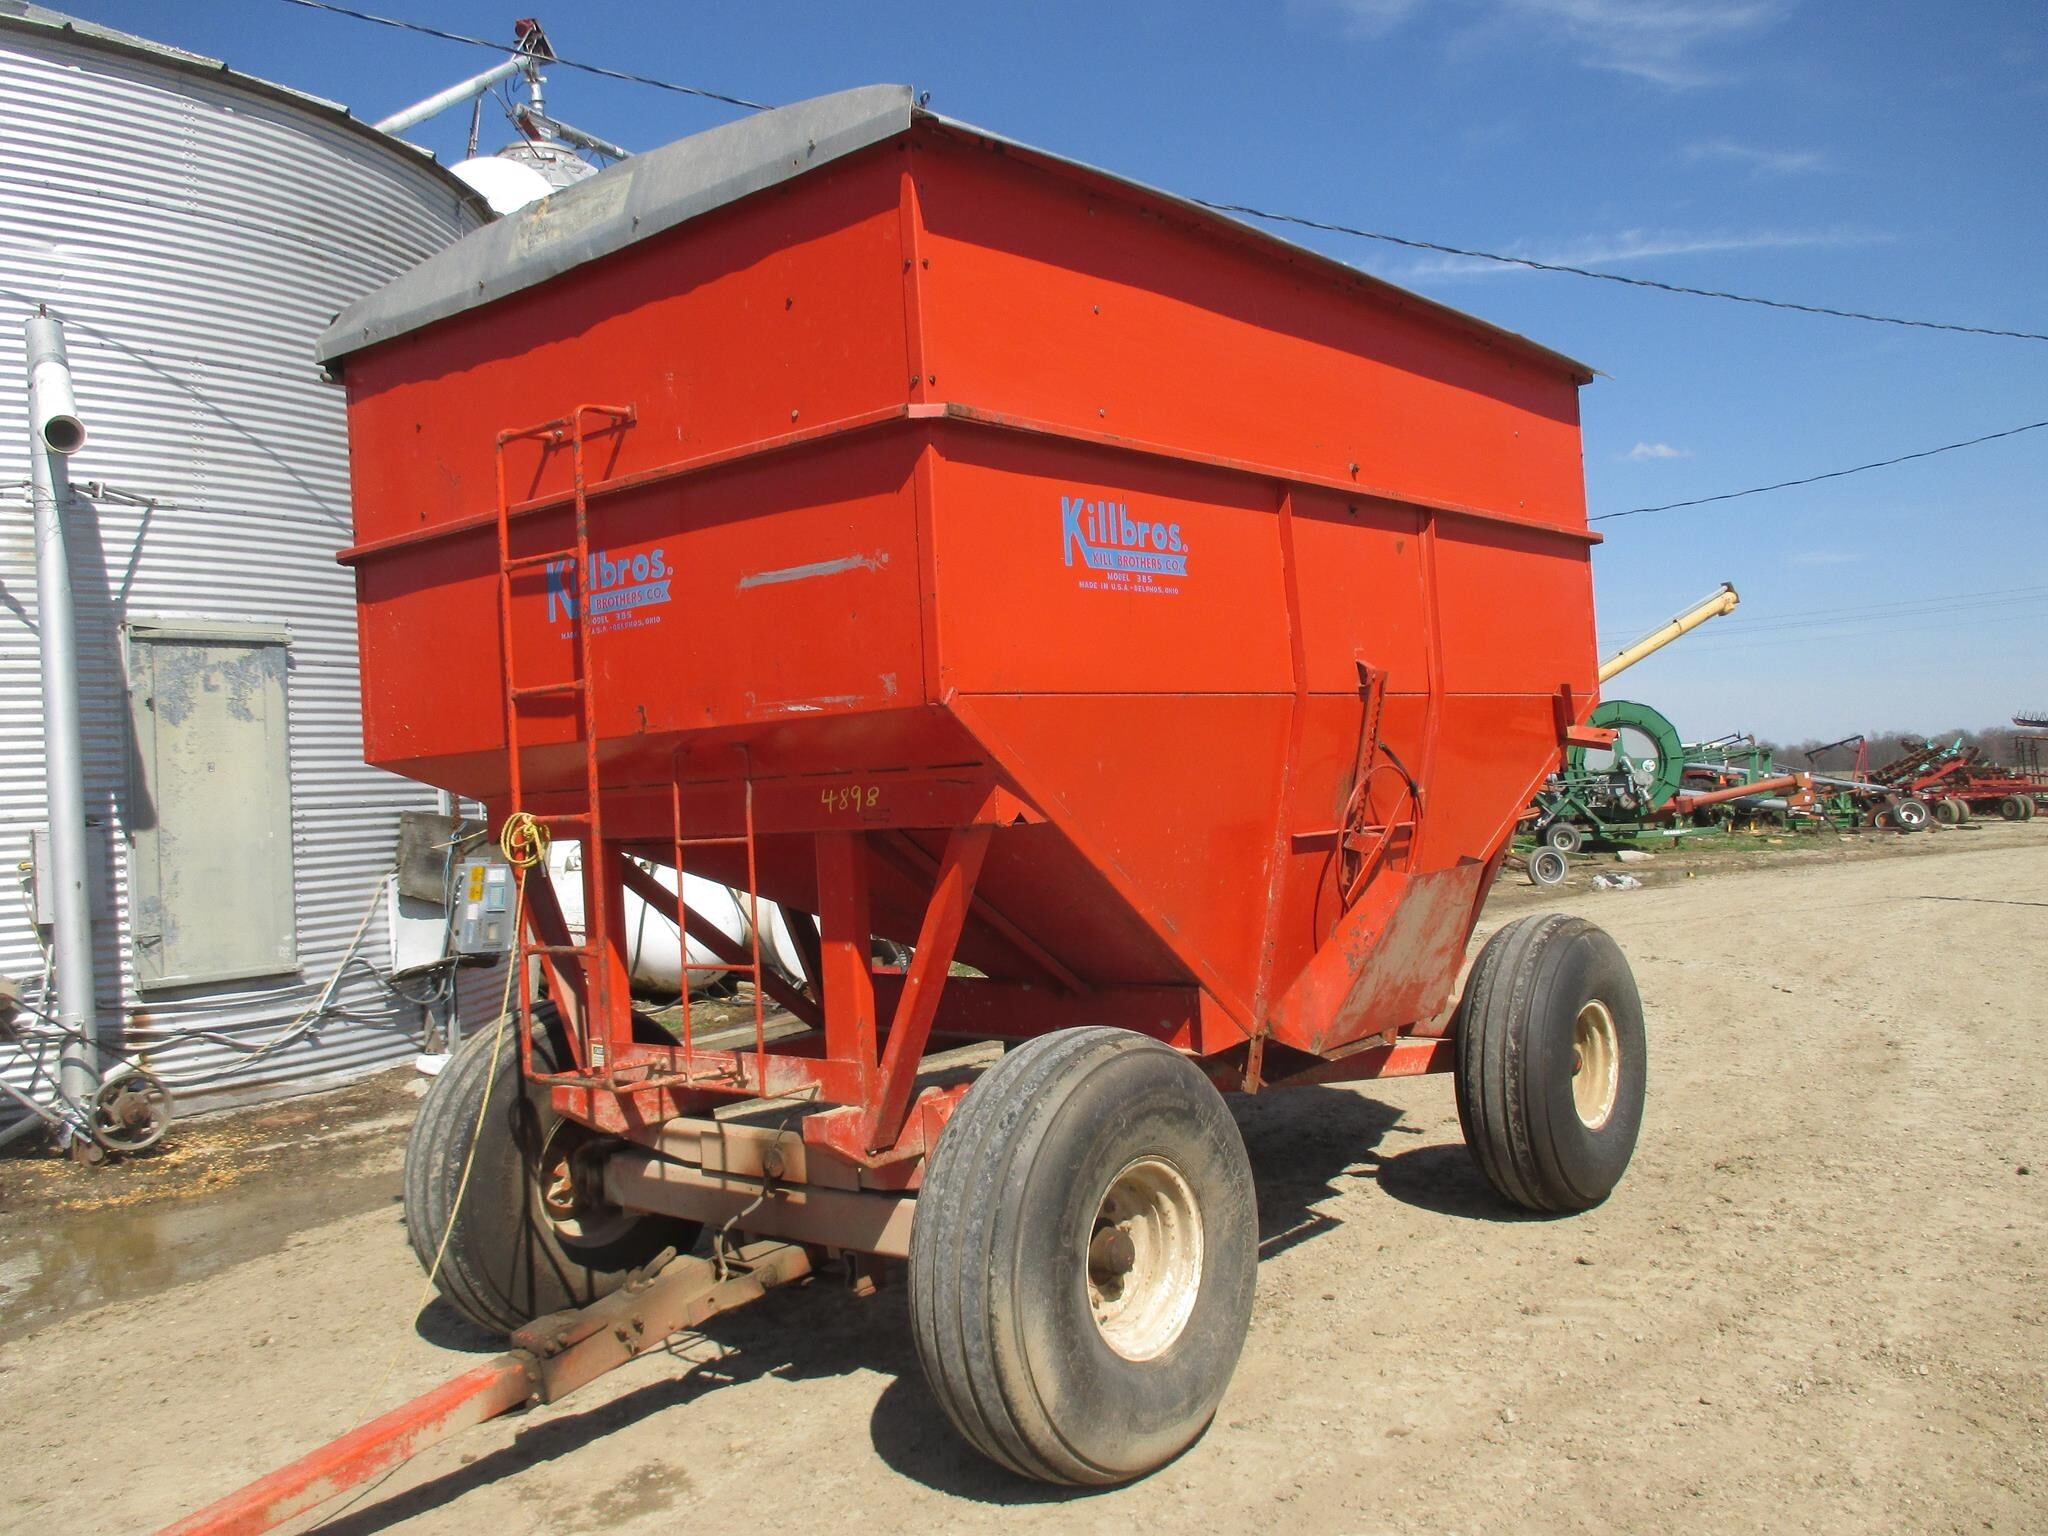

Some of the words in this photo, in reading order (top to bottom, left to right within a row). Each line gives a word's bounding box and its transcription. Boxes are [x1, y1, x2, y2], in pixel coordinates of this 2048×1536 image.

[1092, 552, 1112, 566] KILL
[1117, 554, 1162, 570] BROTHERS
[545, 547, 674, 623] Kilbros.
[1107, 572, 1131, 582] MODEL
[1136, 574, 1153, 583] 385
[1078, 580, 1098, 590] MADE
[1100, 582, 1109, 590] IN
[1164, 587, 1179, 595] OHIO
[595, 591, 642, 610] BROTHERS
[591, 615, 609, 625] ODEL
[821, 785, 880, 814] 4898
